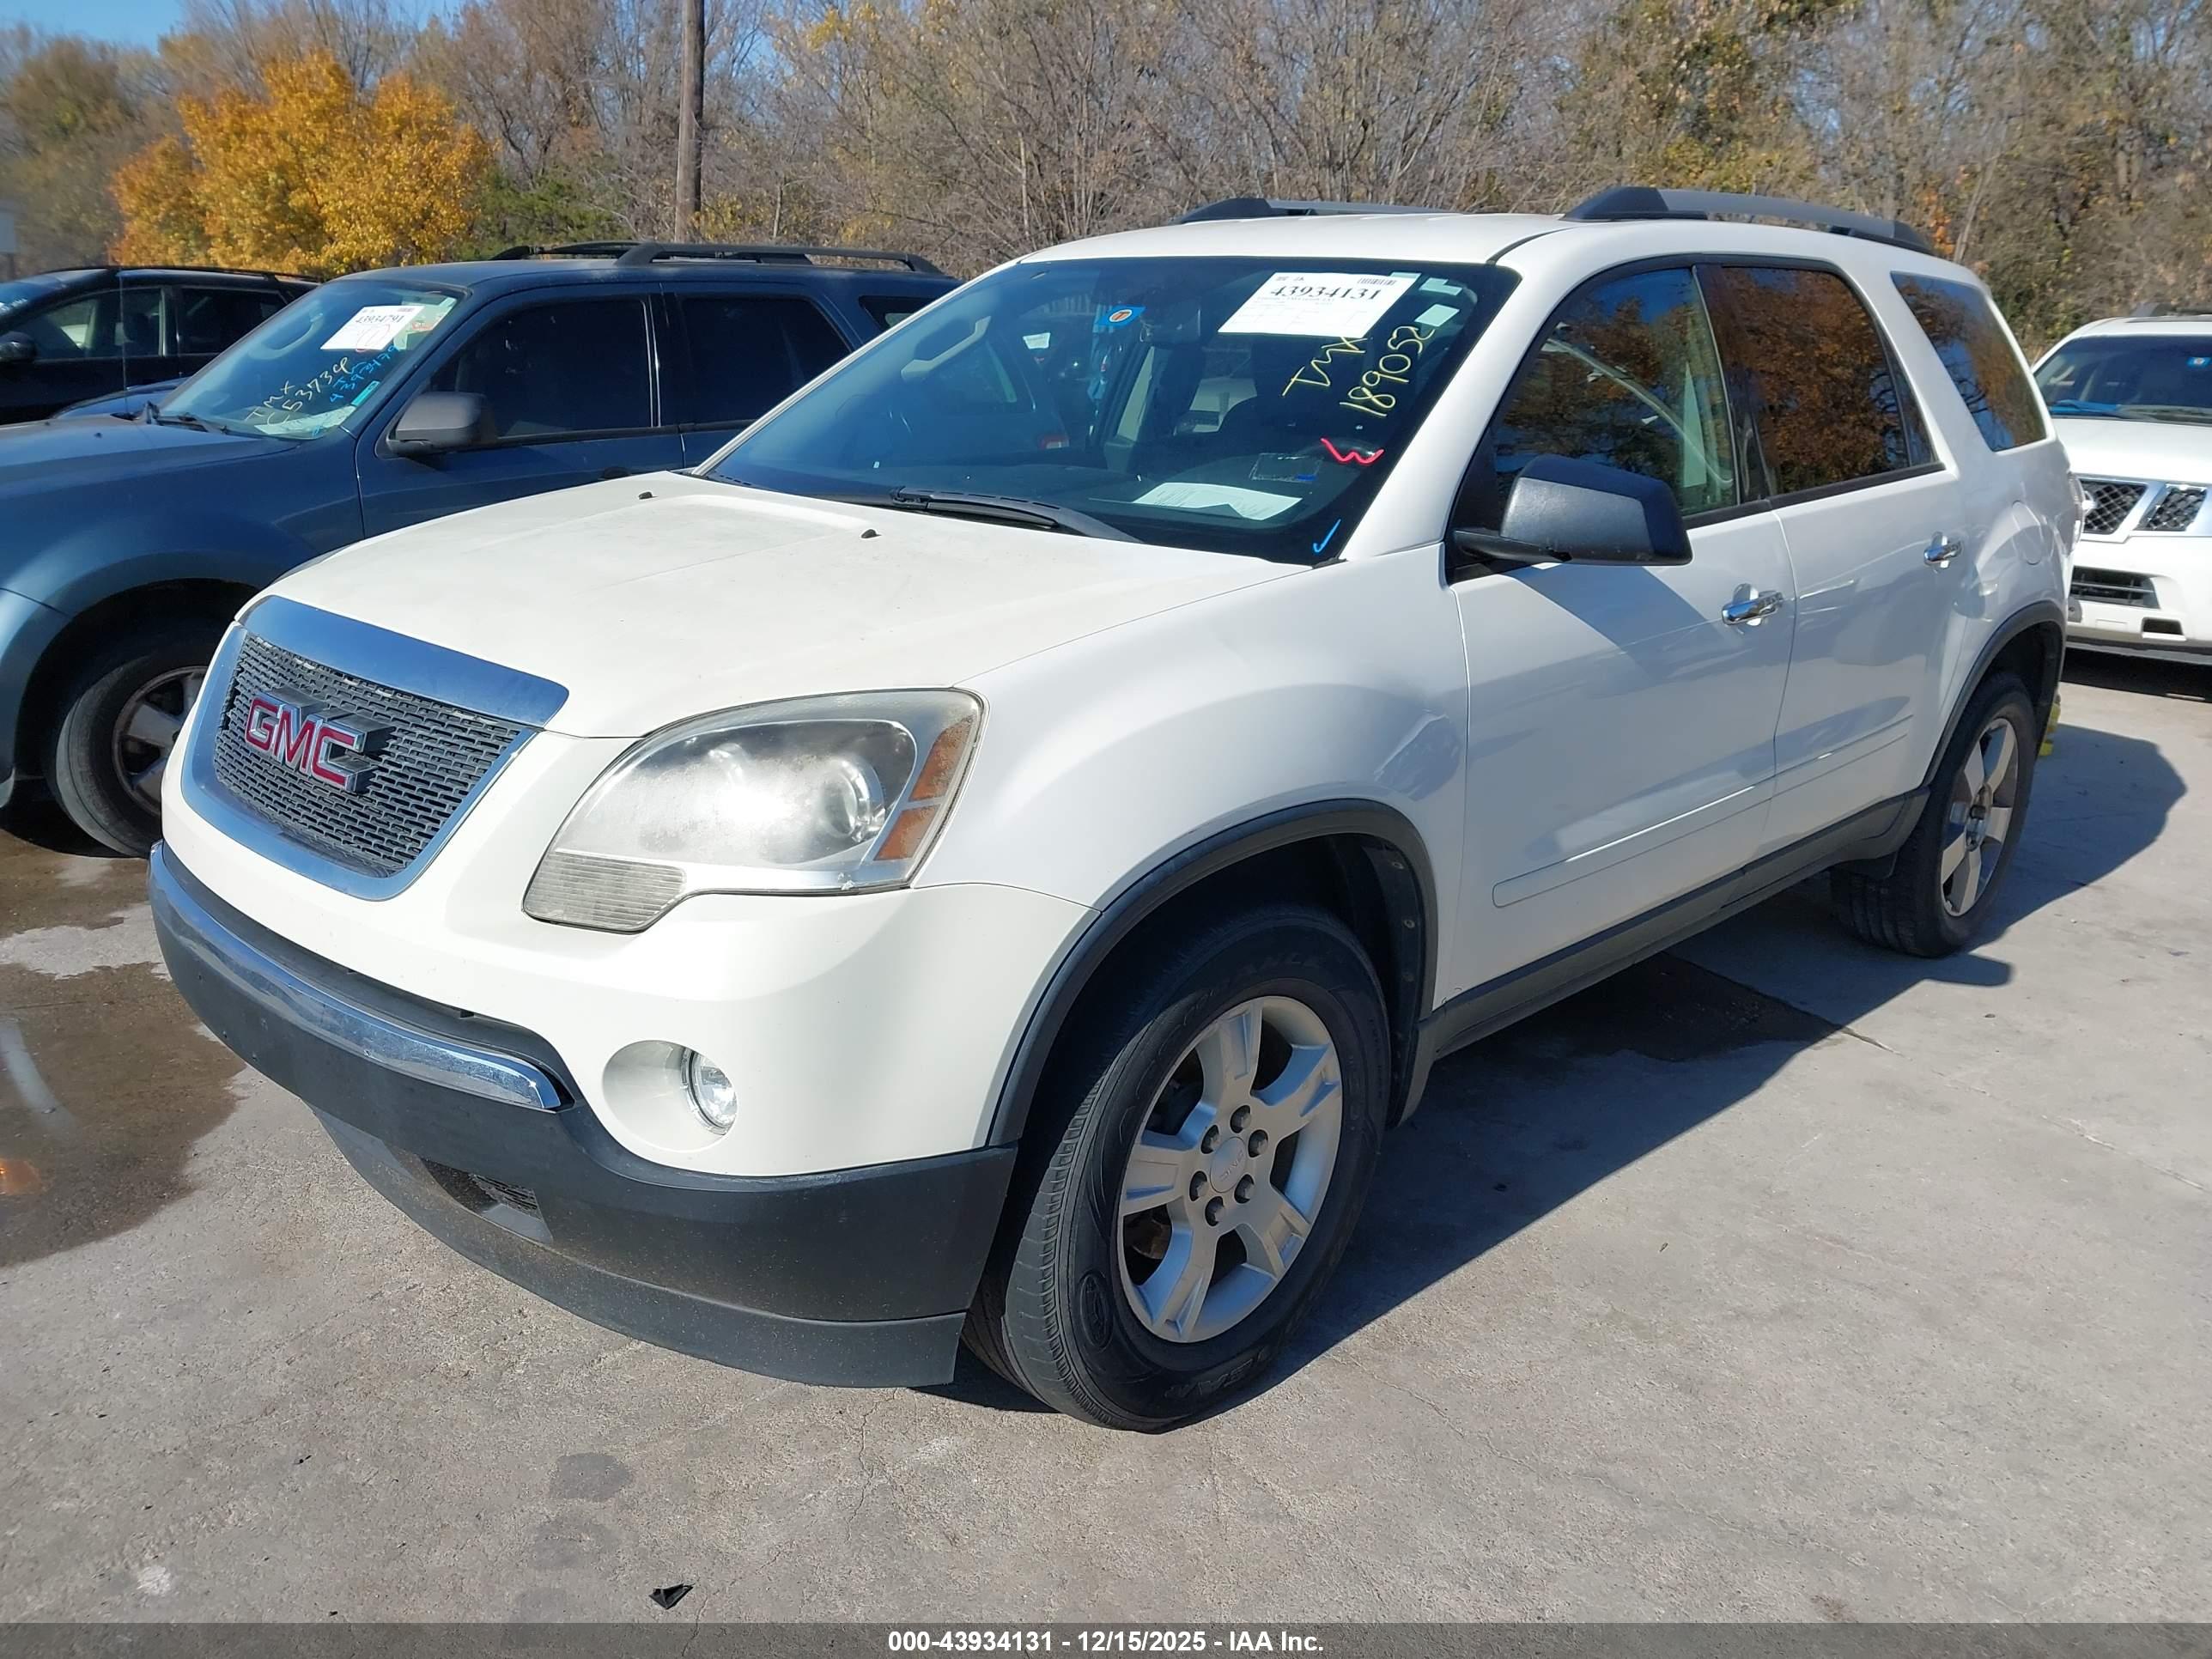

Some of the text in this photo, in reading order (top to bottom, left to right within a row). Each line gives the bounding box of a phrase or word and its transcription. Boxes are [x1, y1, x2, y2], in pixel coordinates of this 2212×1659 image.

[1271, 285, 1381, 300] 43934131
[1339, 325, 1436, 416] 189052
[245, 696, 364, 792] GMC
